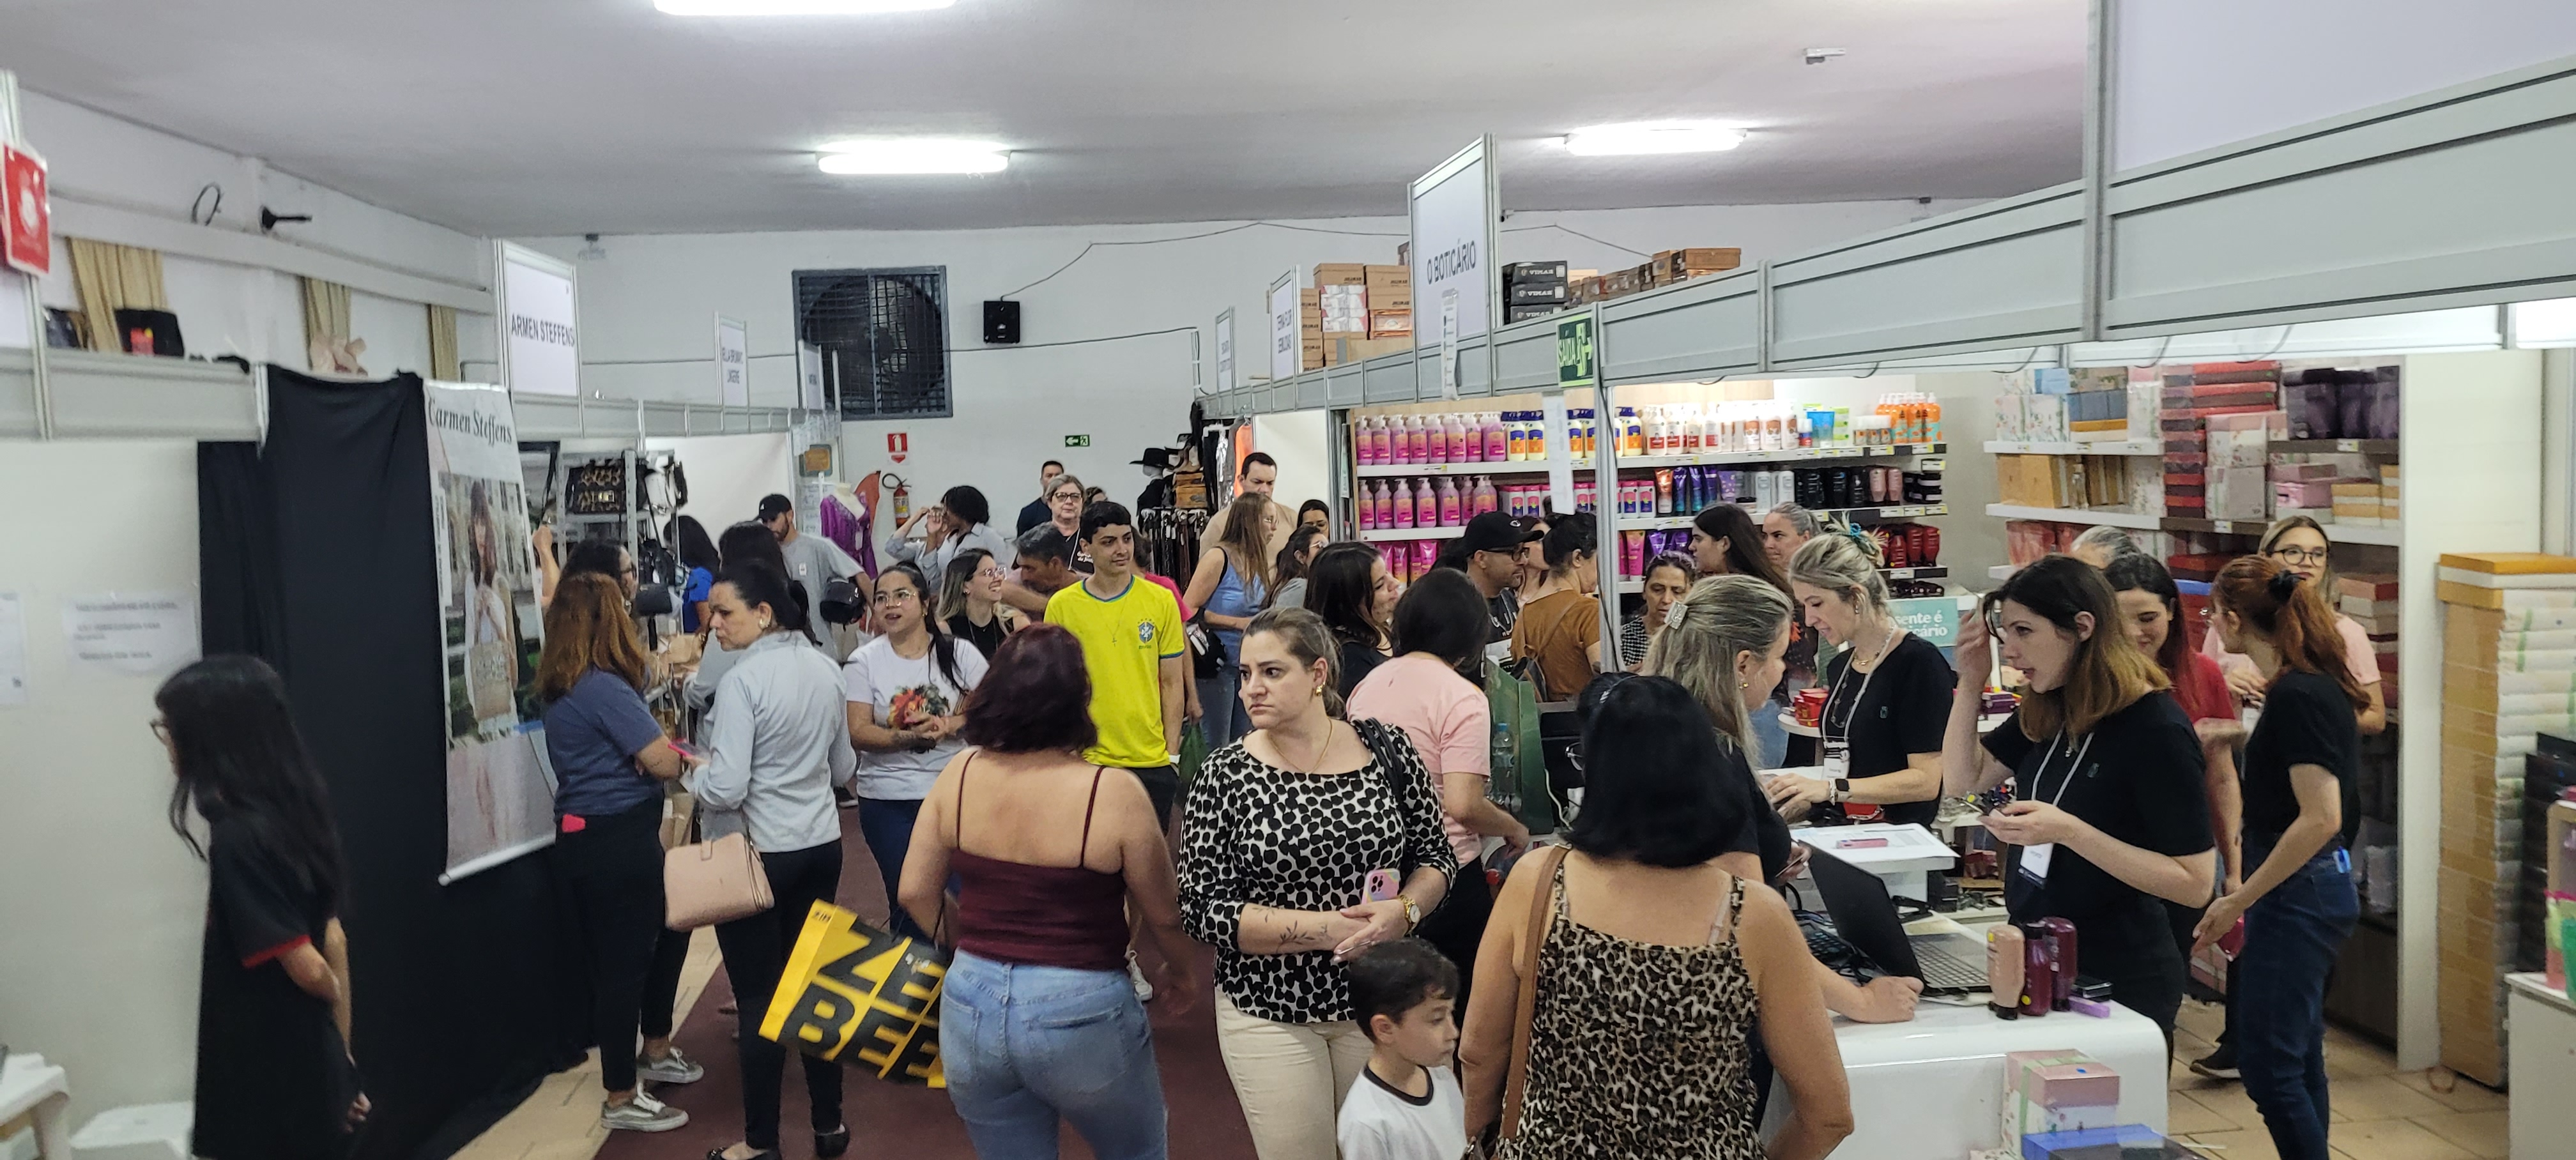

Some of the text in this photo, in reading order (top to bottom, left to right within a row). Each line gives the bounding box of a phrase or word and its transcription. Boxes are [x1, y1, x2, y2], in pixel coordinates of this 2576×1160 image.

[1427, 238, 1476, 285] O BOTICÁRIO
[511, 313, 574, 347] ARMEN STEFFENS
[428, 396, 512, 448] Carmen Steffens
[1893, 609, 1943, 625] sente é
[818, 917, 950, 1020] ZE
